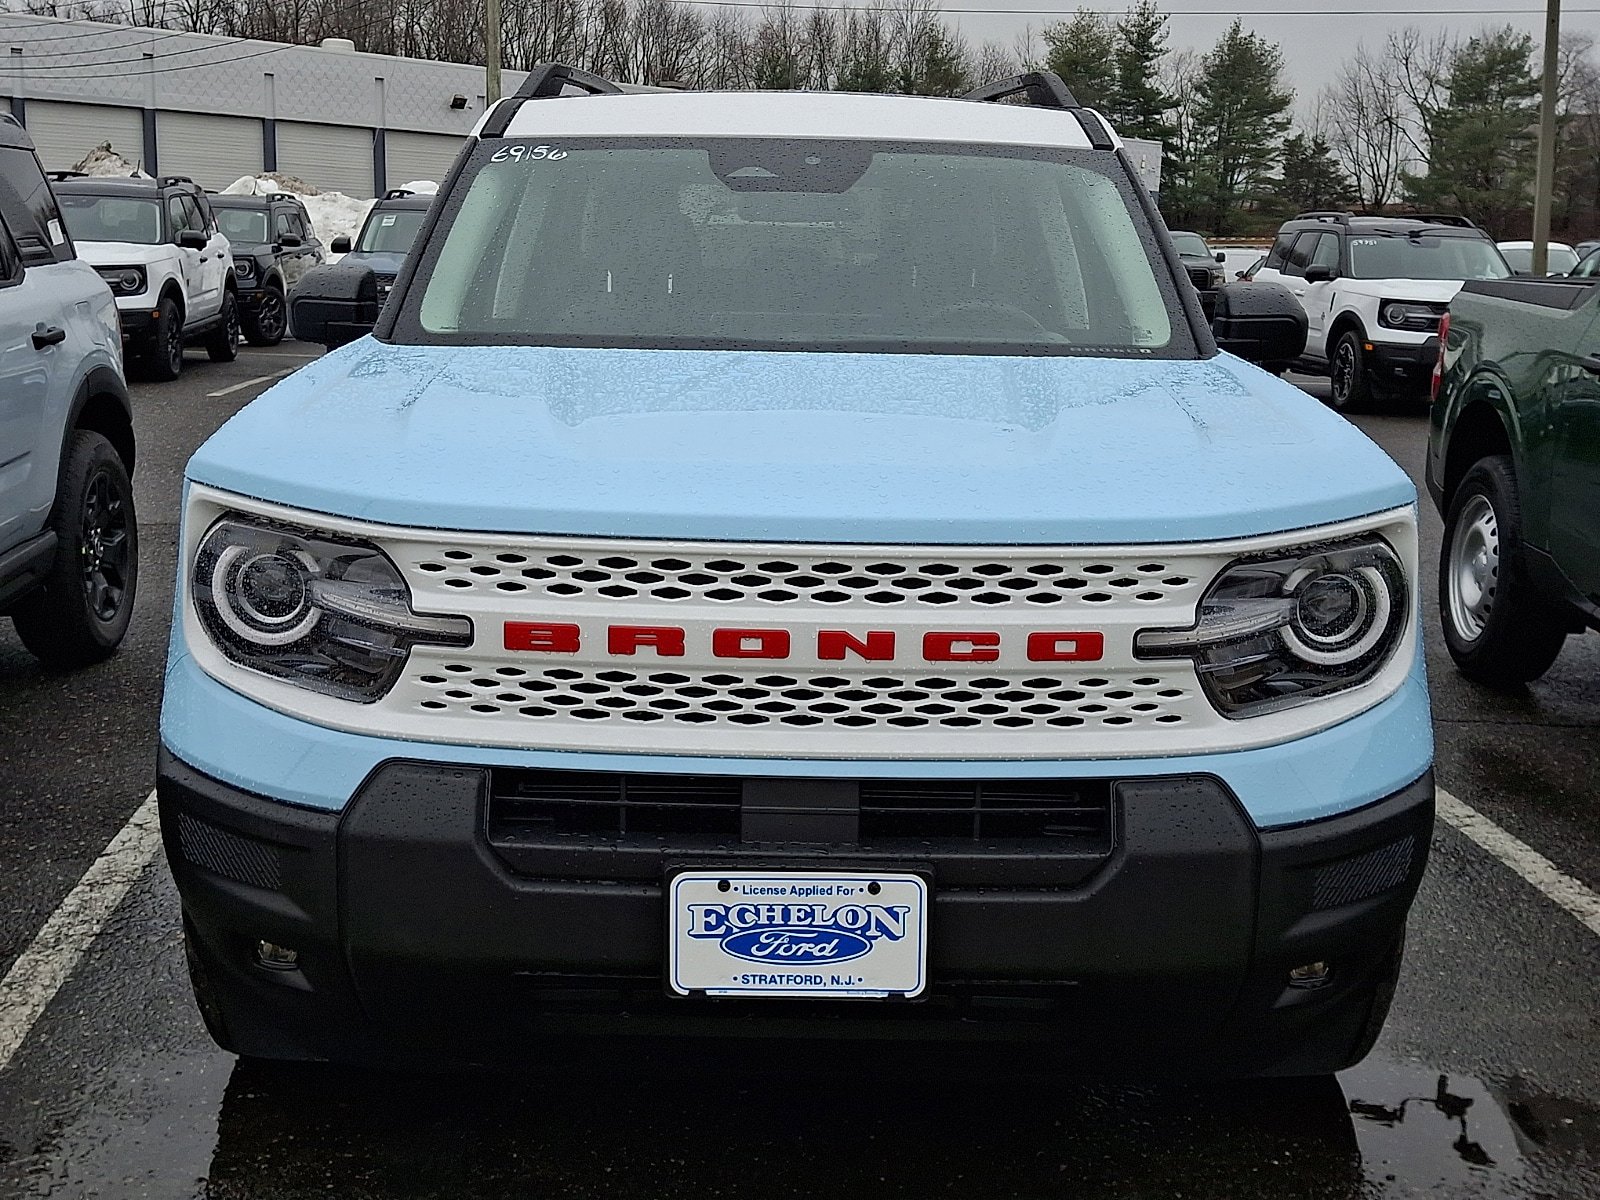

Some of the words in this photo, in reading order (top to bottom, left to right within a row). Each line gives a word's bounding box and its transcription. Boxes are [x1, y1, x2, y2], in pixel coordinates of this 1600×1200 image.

[490, 145, 568, 162] 69156
[503, 621, 1104, 661] BRONCO
[742, 885, 787, 896] License
[790, 885, 834, 897] Applied
[836, 885, 855, 896] For
[687, 904, 911, 941] ECHELON
[750, 931, 839, 957] Ford
[741, 974, 827, 988] STRATFORD,
[830, 975, 856, 987] N.J.
